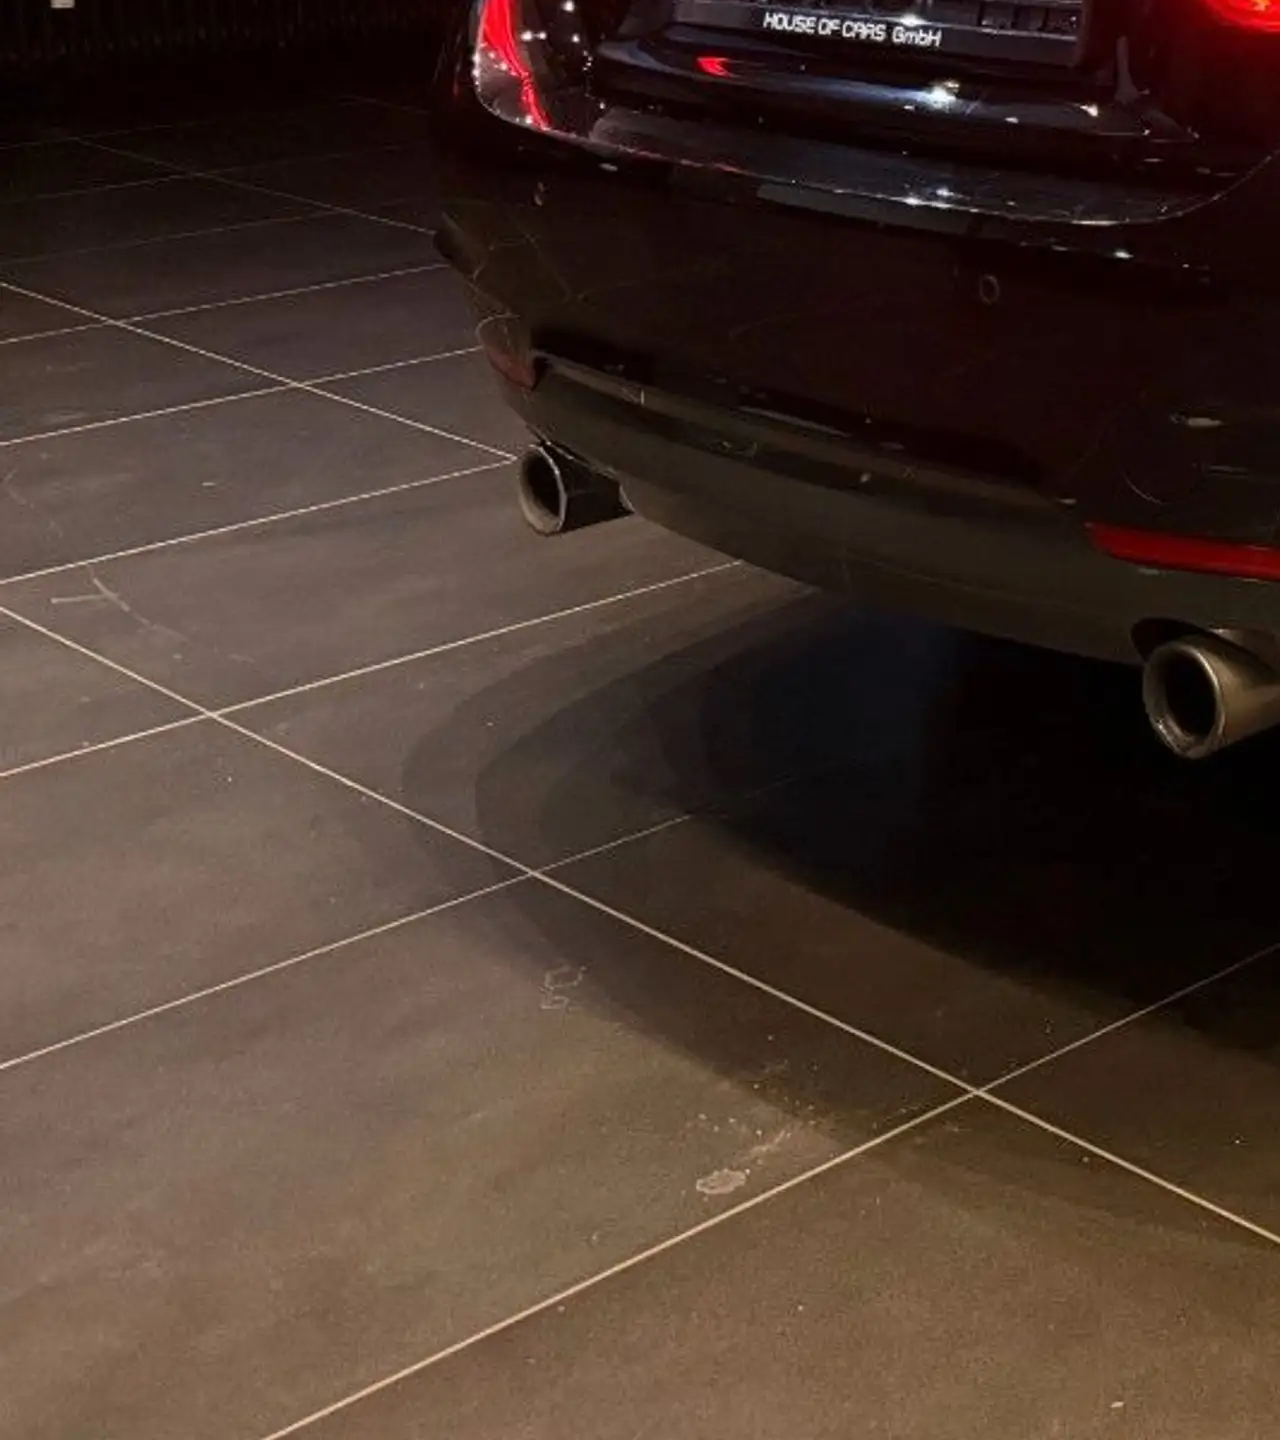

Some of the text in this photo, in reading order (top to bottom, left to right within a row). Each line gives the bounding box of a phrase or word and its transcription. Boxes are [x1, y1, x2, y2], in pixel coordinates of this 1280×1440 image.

[763, 11, 942, 48] HOUSE OF CARS GmbH
